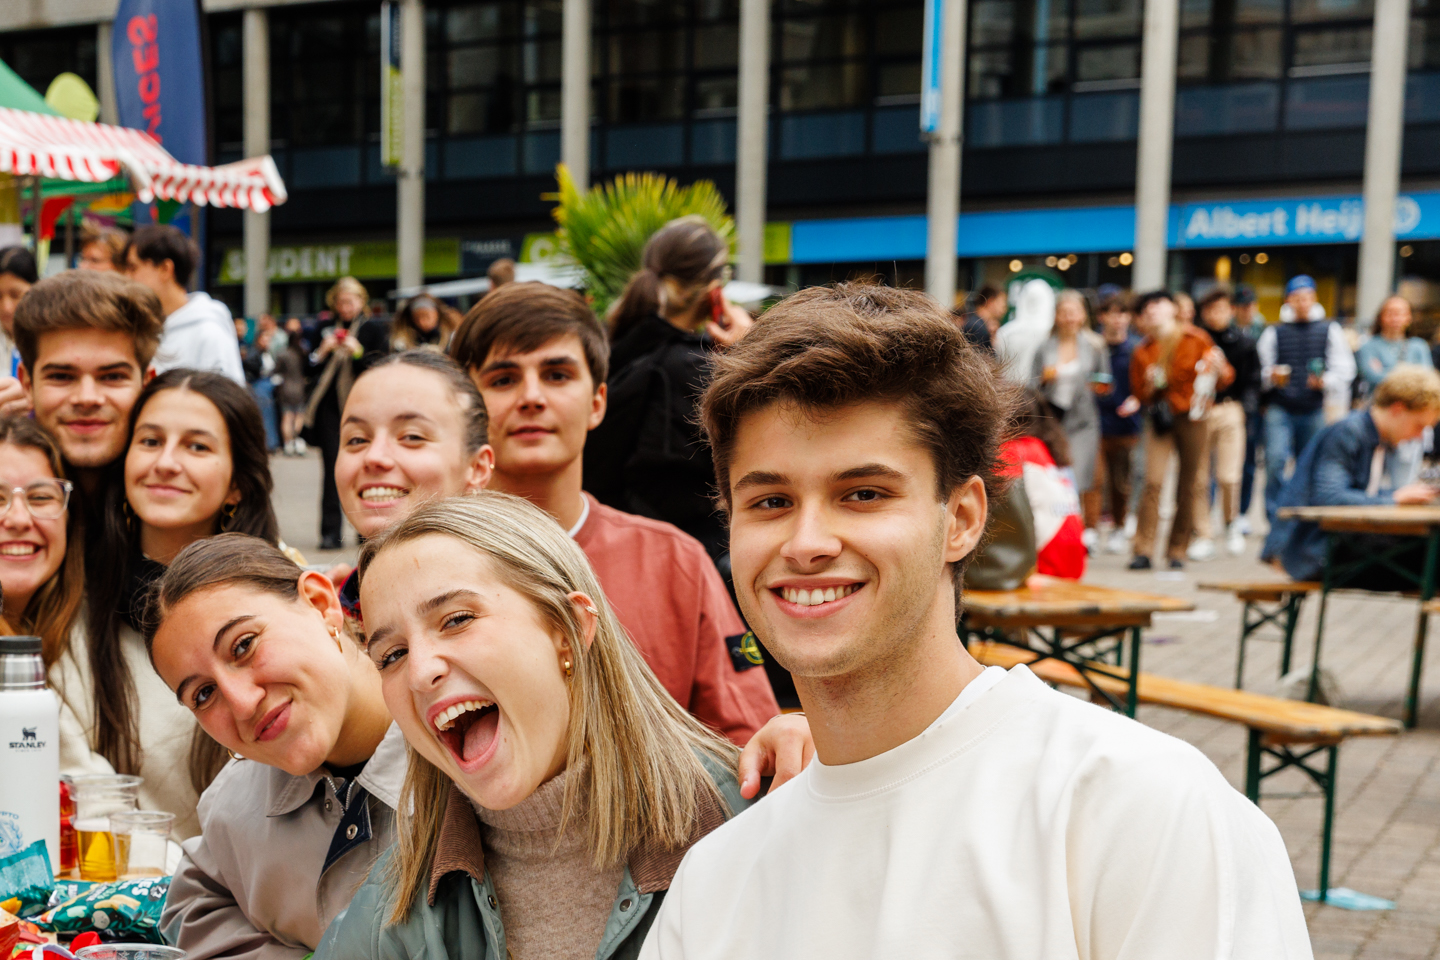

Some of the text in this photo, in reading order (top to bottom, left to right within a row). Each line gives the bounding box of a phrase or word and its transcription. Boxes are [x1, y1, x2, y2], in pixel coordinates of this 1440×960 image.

[1187, 200, 1363, 240] Albert Heij
[227, 246, 353, 278] SUDENT
[9, 741, 46, 749] STANLEY
